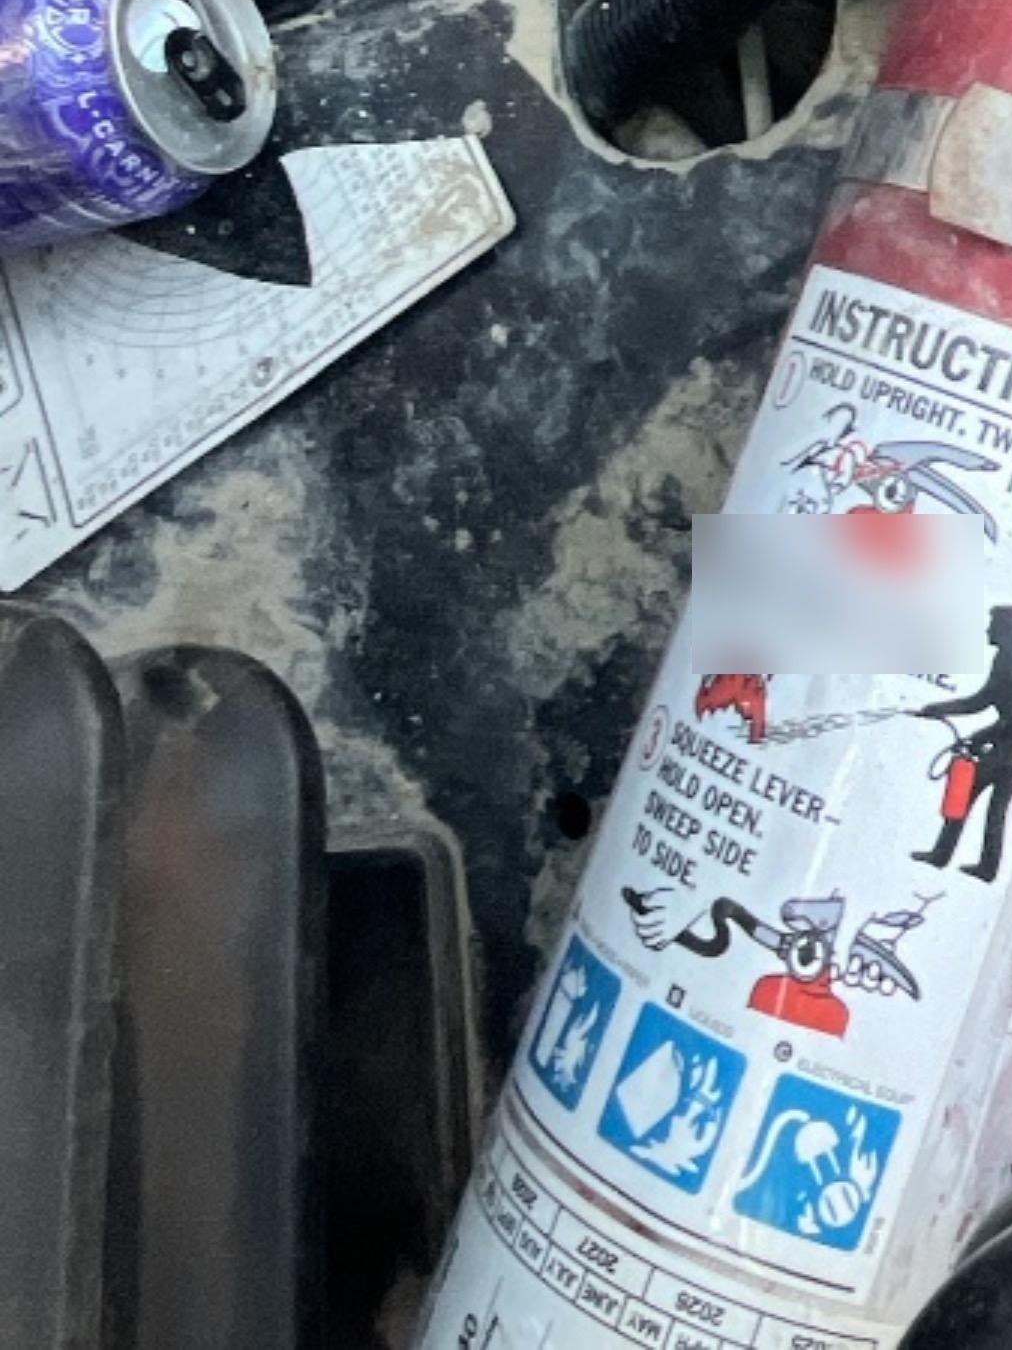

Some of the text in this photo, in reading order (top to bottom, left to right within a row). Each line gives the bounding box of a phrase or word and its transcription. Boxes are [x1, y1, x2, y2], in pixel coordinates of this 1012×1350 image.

[809, 356, 857, 392] HOLD
[860, 375, 967, 436] UPRIGHT.
[671, 721, 750, 785] SQUEEZE
[644, 789, 758, 876] SWEEP SIDE
[656, 755, 763, 838] HOLD OPEN.
[632, 822, 698, 889] TO SIDE.
[627, 1313, 662, 1340] MAY
